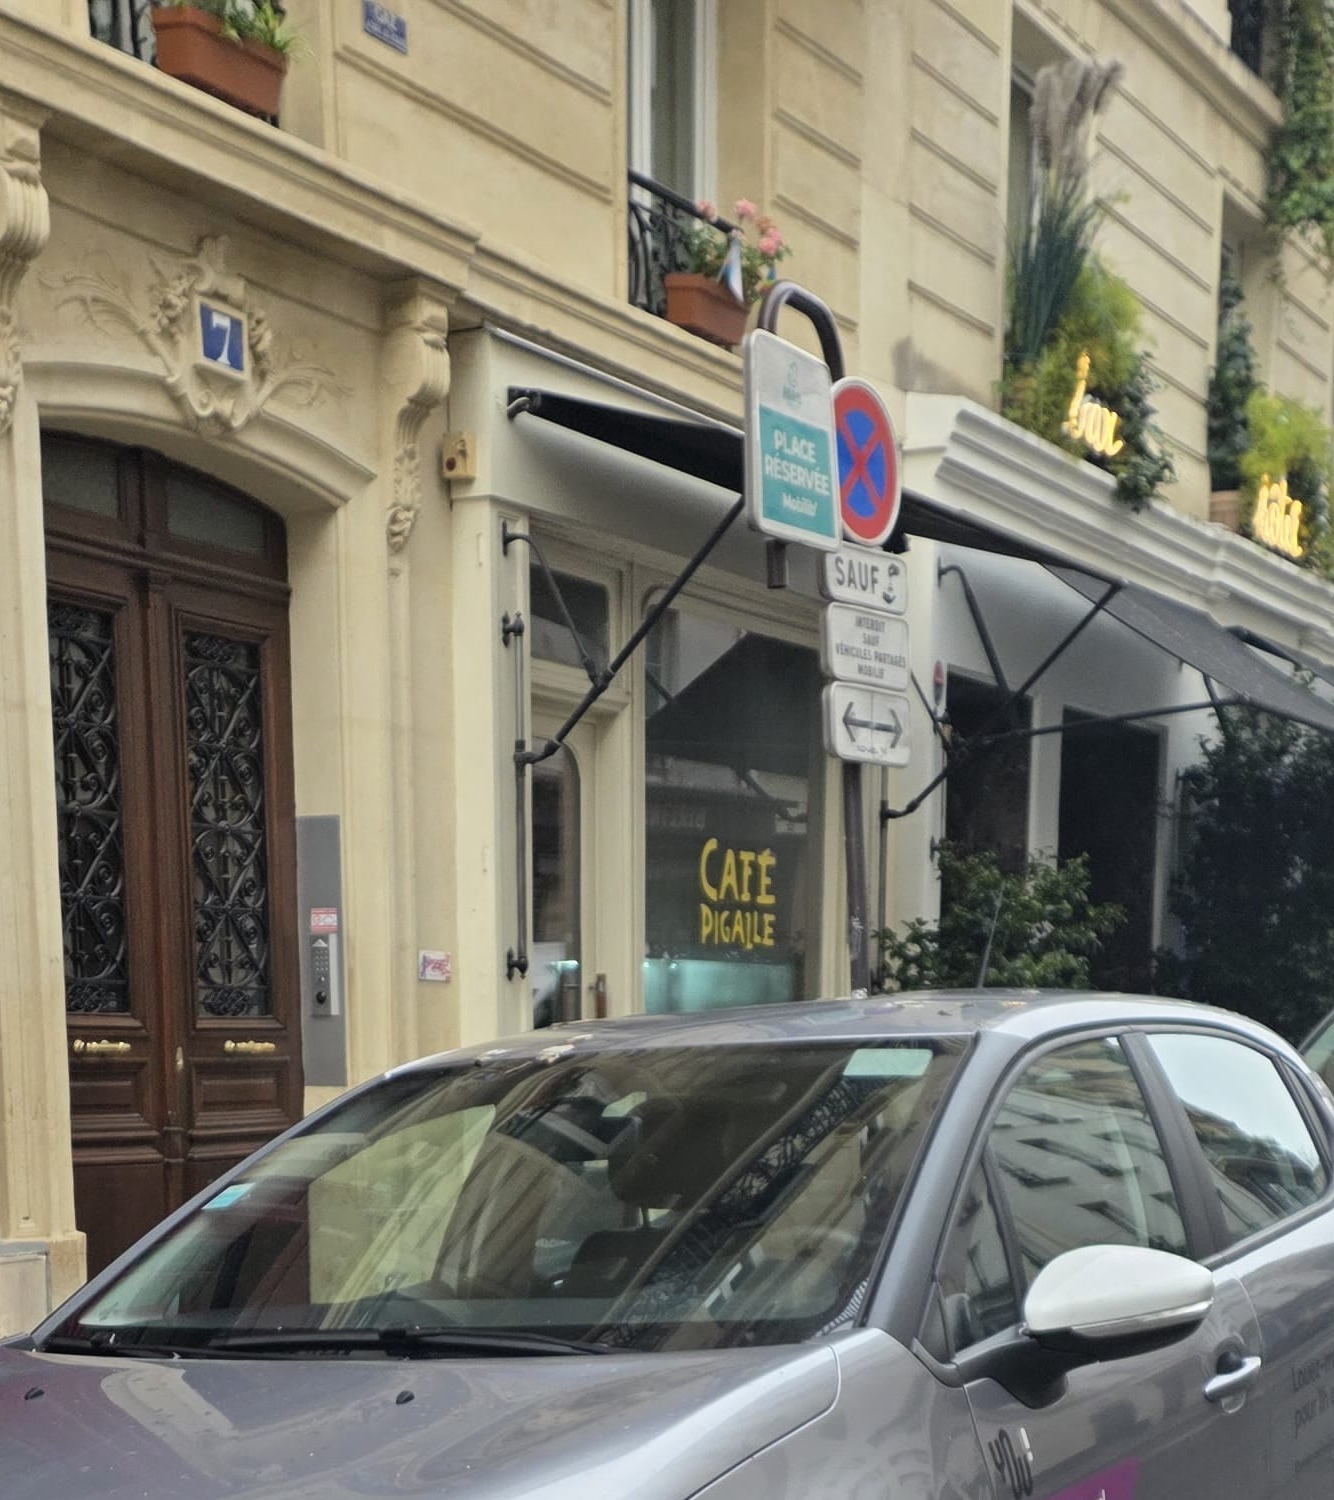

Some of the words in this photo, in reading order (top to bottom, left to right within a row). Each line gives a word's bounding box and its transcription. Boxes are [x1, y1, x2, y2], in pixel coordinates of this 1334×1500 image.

[212, 311, 231, 365] 7
[773, 429, 816, 464] PLACE
[764, 452, 831, 497] RÉSERVÉE
[834, 556, 880, 594] SAUF
[862, 632, 881, 647] SAUF
[700, 903, 776, 950] PIGALLE
